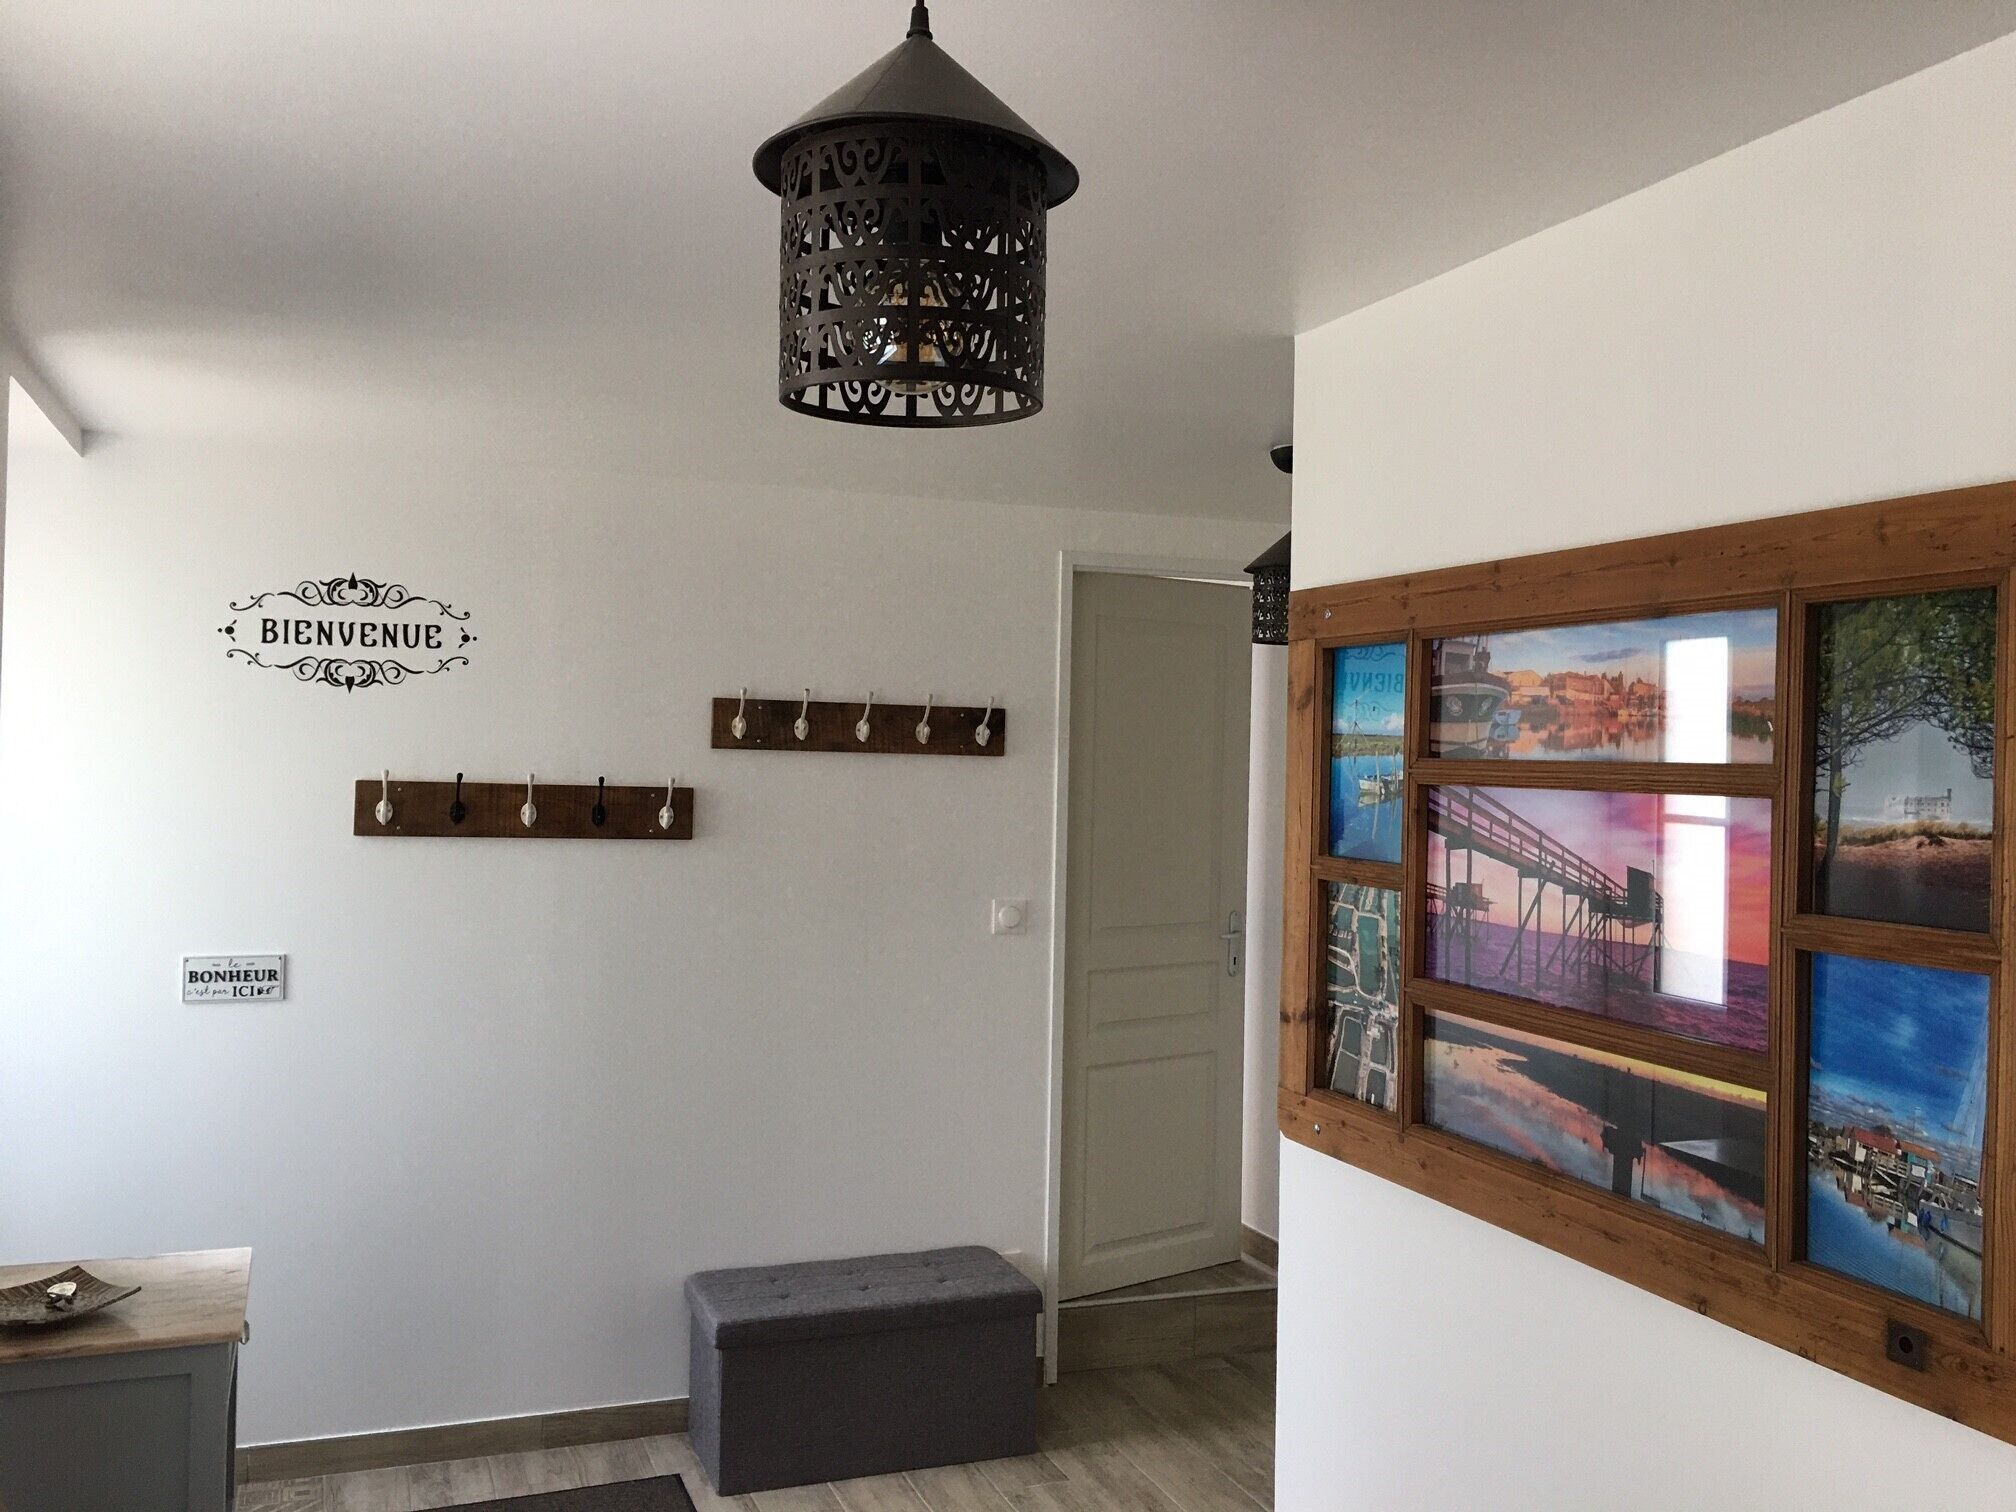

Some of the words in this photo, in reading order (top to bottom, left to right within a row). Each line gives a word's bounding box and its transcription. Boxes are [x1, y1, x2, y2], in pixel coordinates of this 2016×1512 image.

[260, 618, 443, 649] BIENVENUE
[228, 958, 241, 969] le
[187, 969, 279, 984] BONHEUR
[212, 988, 230, 997] par
[232, 985, 255, 998] ICI
